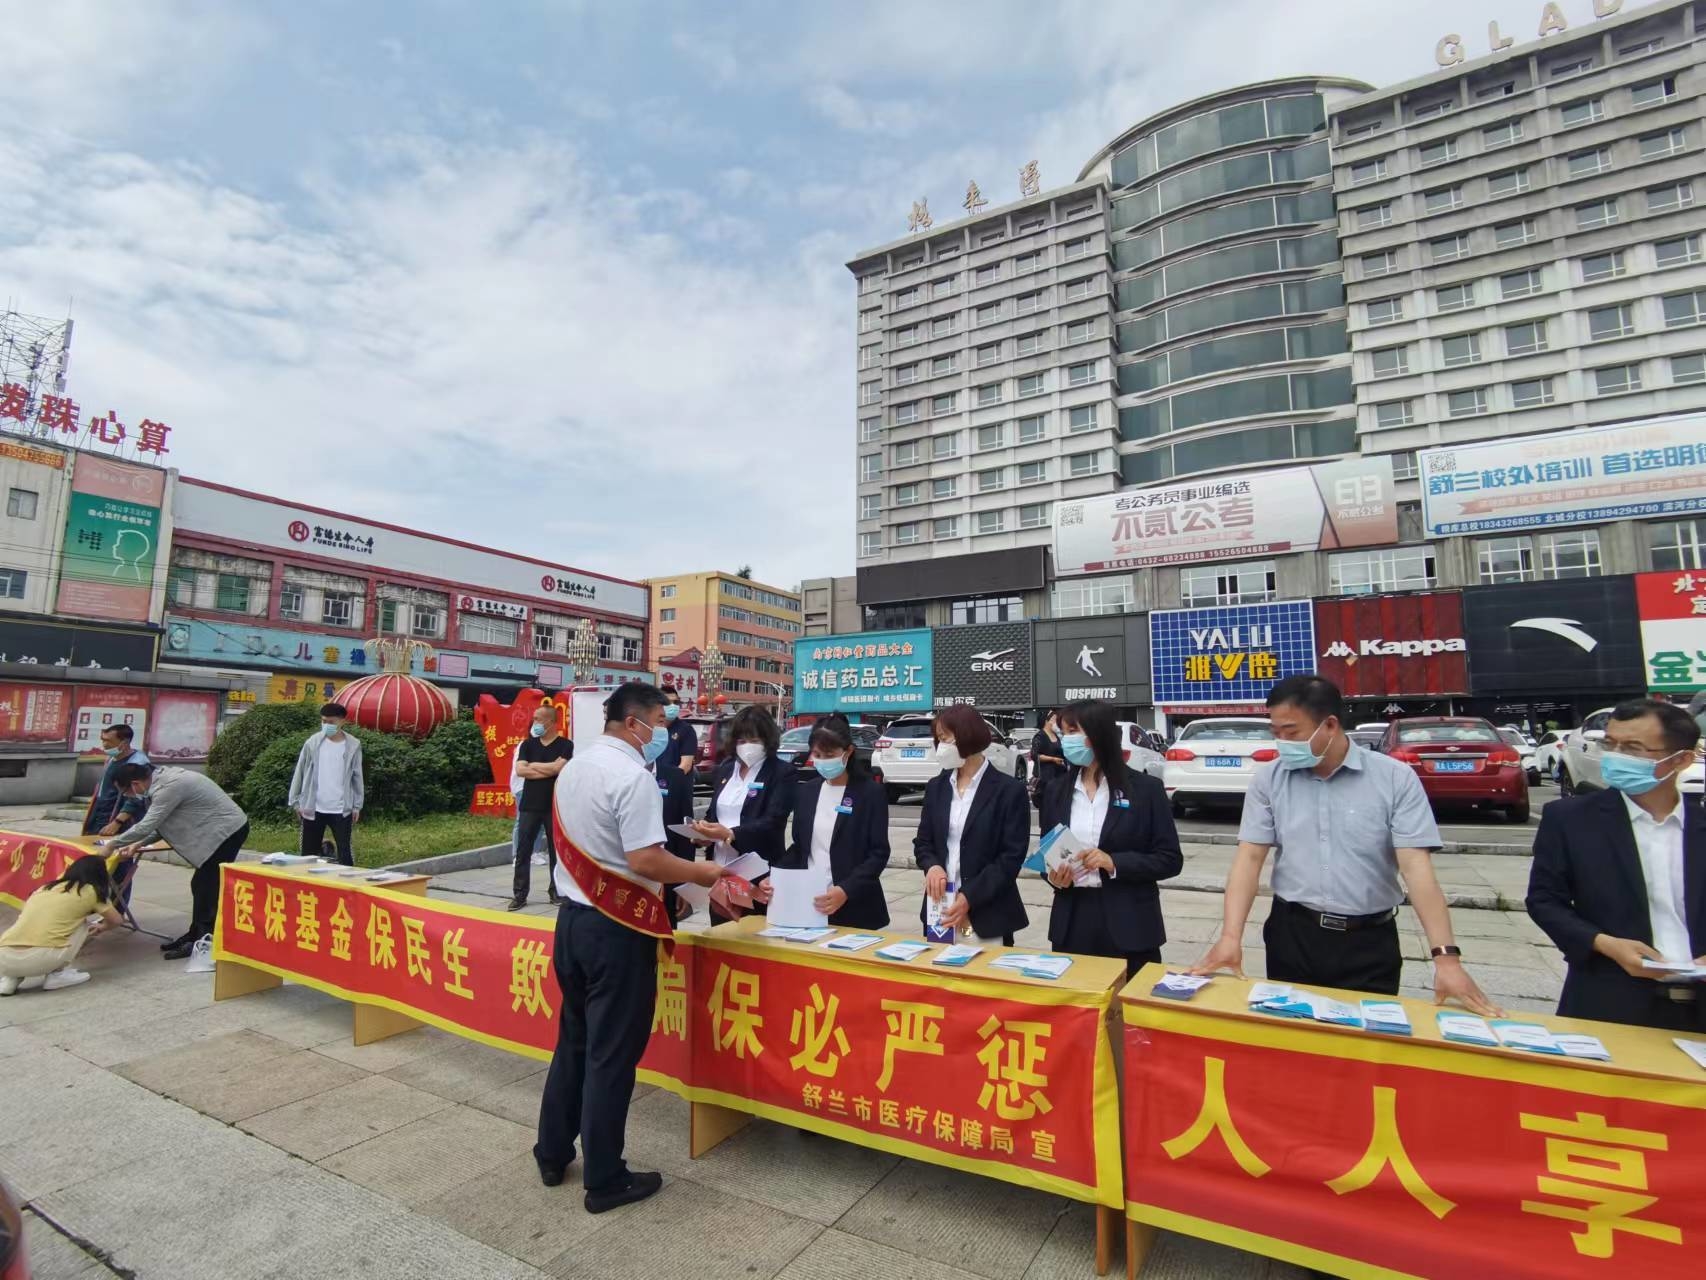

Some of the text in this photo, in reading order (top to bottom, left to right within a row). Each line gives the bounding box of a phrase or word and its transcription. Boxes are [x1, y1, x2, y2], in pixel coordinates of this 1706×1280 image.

[1115, 480, 1250, 511] 考公务员事业编选
[313, 525, 375, 549] 富德生命人寿
[356, 546, 373, 554] LIFE
[1190, 624, 1272, 650] YALU
[1360, 637, 1467, 657] Kappa
[801, 665, 923, 689] 诚信药品总汇
[971, 661, 1014, 671] ERKE
[934, 696, 976, 707] 鸿星尔克
[476, 791, 515, 806] 坚定不移
[233, 878, 474, 1000] 医保基金保民生
[801, 1081, 1057, 1164] 舒兰市医疗保障局 宣
[1159, 1055, 1684, 1259] 人人享
